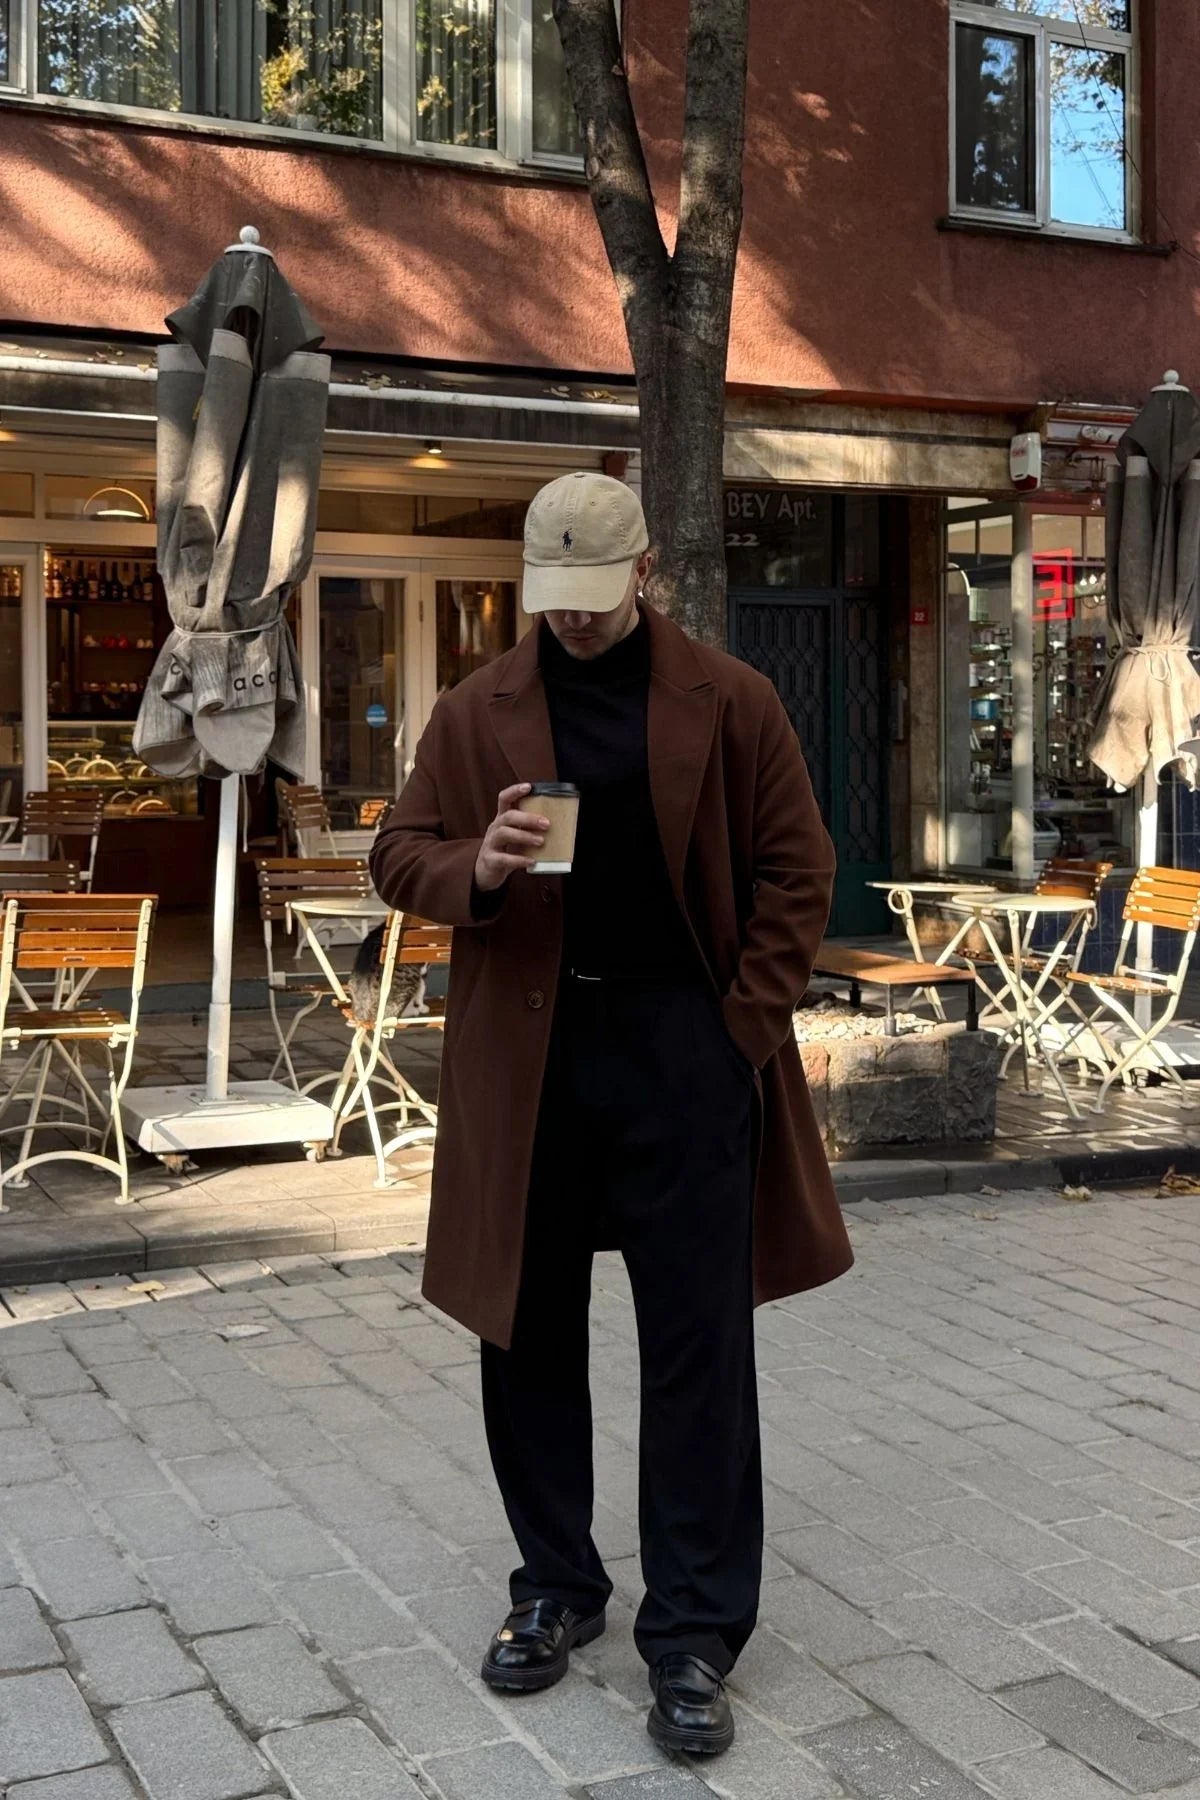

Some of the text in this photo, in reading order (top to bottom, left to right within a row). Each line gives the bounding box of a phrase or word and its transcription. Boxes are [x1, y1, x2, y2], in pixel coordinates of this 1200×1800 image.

[726, 492, 817, 525] BEY Apt.
[726, 533, 760, 547] 22
